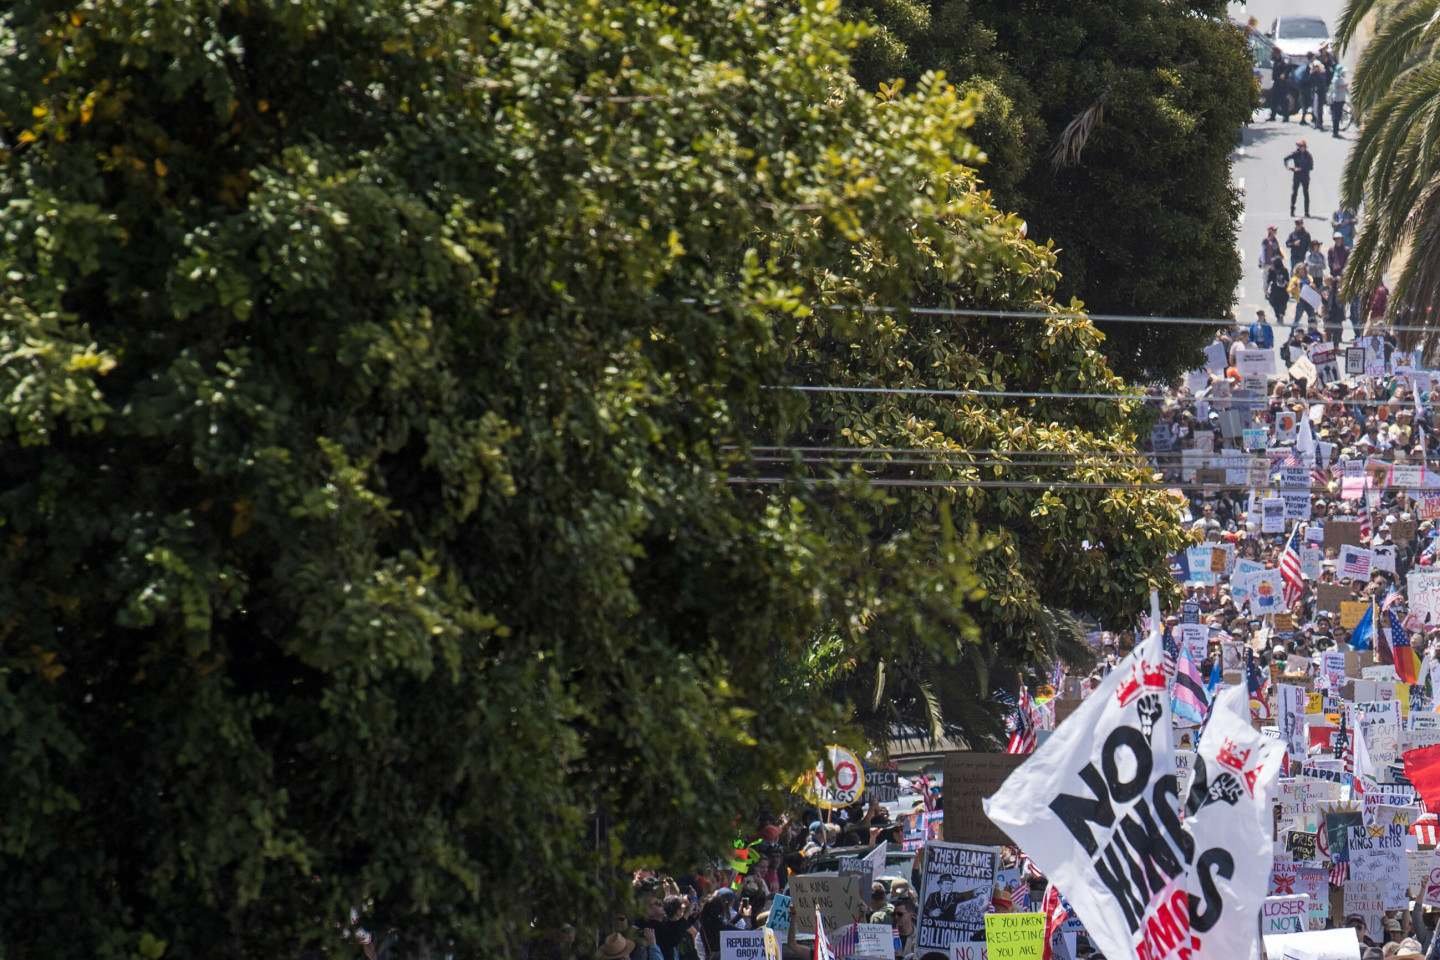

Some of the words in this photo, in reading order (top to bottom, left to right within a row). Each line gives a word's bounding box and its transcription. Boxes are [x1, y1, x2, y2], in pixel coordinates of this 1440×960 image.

[1050, 724, 1153, 859] NO
[1353, 826, 1367, 838] NO
[1389, 823, 1402, 836] NO
[1349, 838, 1373, 850] KINGS
[933, 847, 960, 863] THEY
[960, 851, 992, 868] BLAME
[927, 862, 993, 879] IMMIGRANTS
[1264, 900, 1306, 916] LOSER
[935, 920, 952, 928] YOU
[986, 916, 996, 928] IF
[1001, 917, 1019, 927] YOU
[987, 929, 1046, 944] RESISTING
[736, 949, 761, 958] GROW
[955, 947, 975, 960] NO
[996, 947, 1014, 958] YOU
[1018, 946, 1038, 956] ARE
